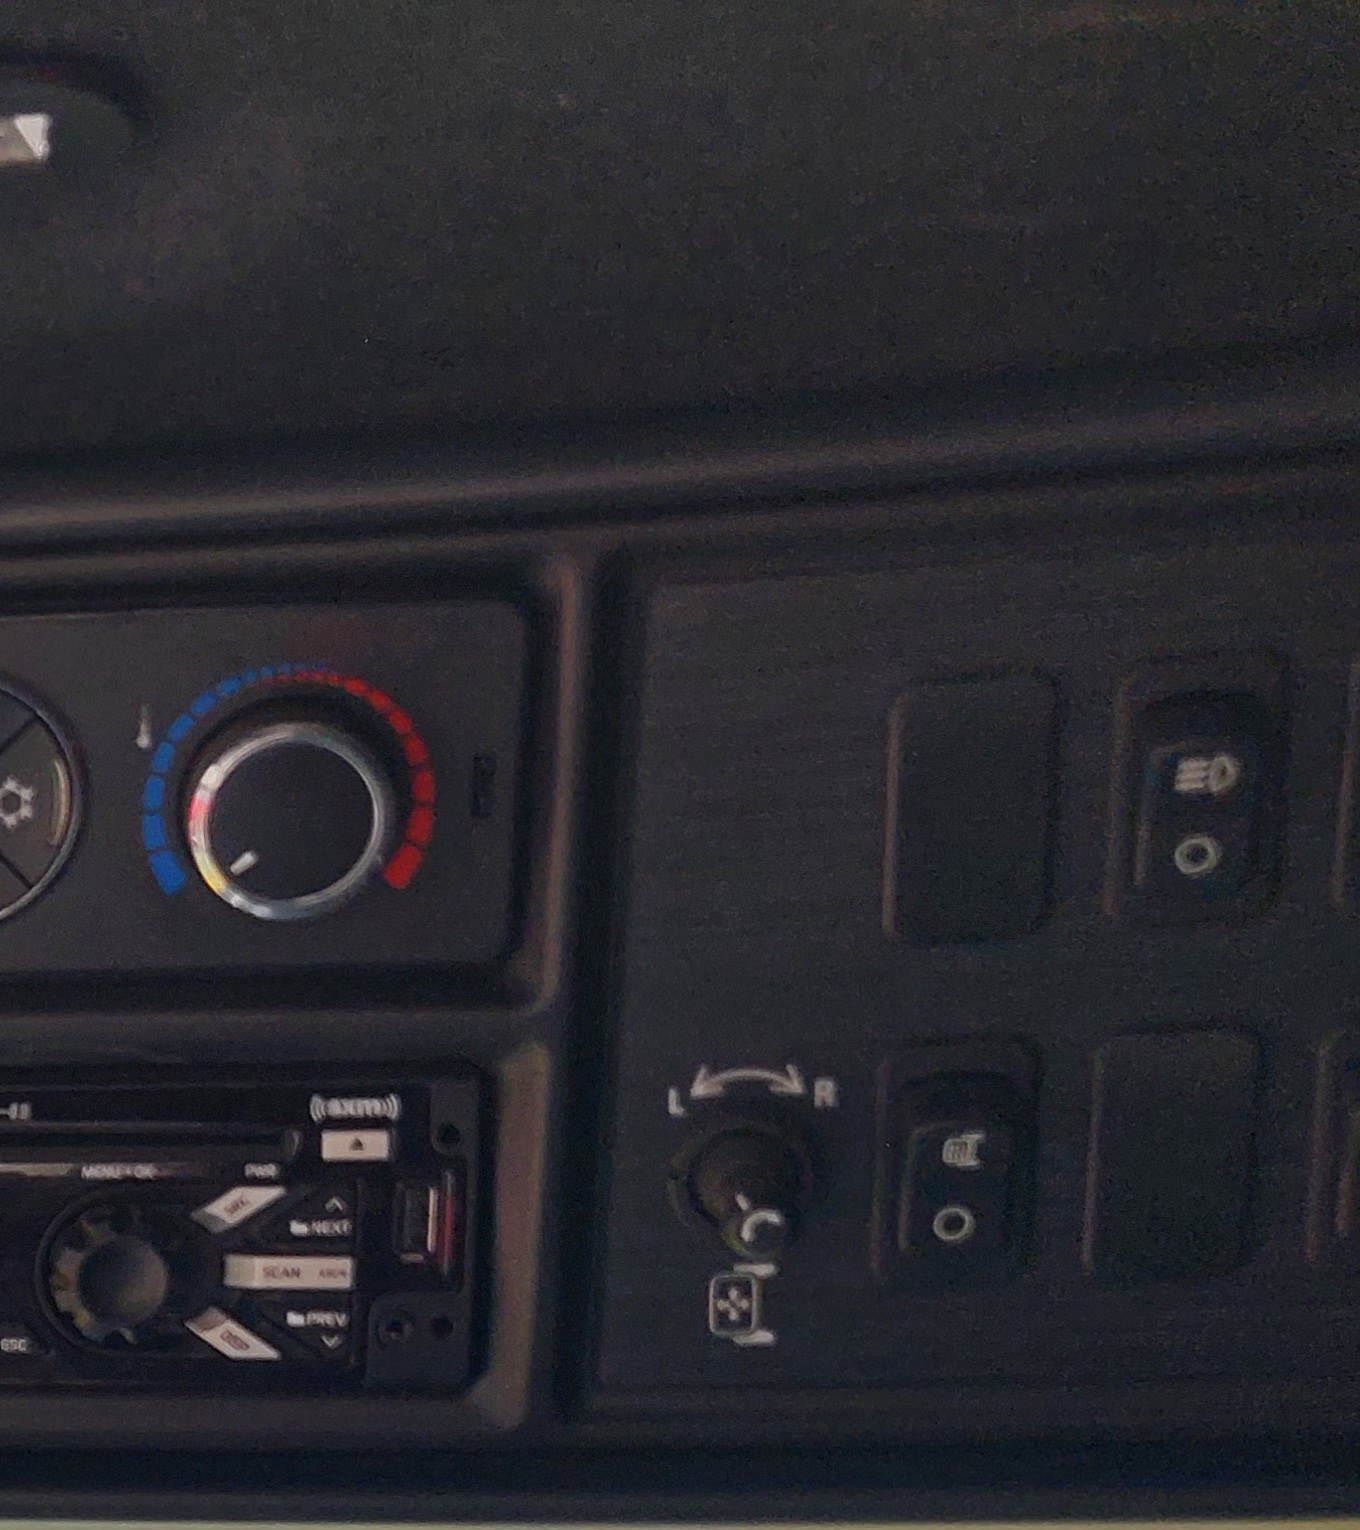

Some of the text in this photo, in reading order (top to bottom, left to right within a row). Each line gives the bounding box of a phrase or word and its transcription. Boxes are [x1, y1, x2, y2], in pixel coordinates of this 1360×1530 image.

[667, 1086, 686, 1116] L
[813, 1077, 838, 1108] R
[244, 1163, 277, 1179] PWR
[310, 1219, 353, 1236] NEXT
[263, 1264, 301, 1279] SCAN
[306, 1311, 349, 1328] PREV
